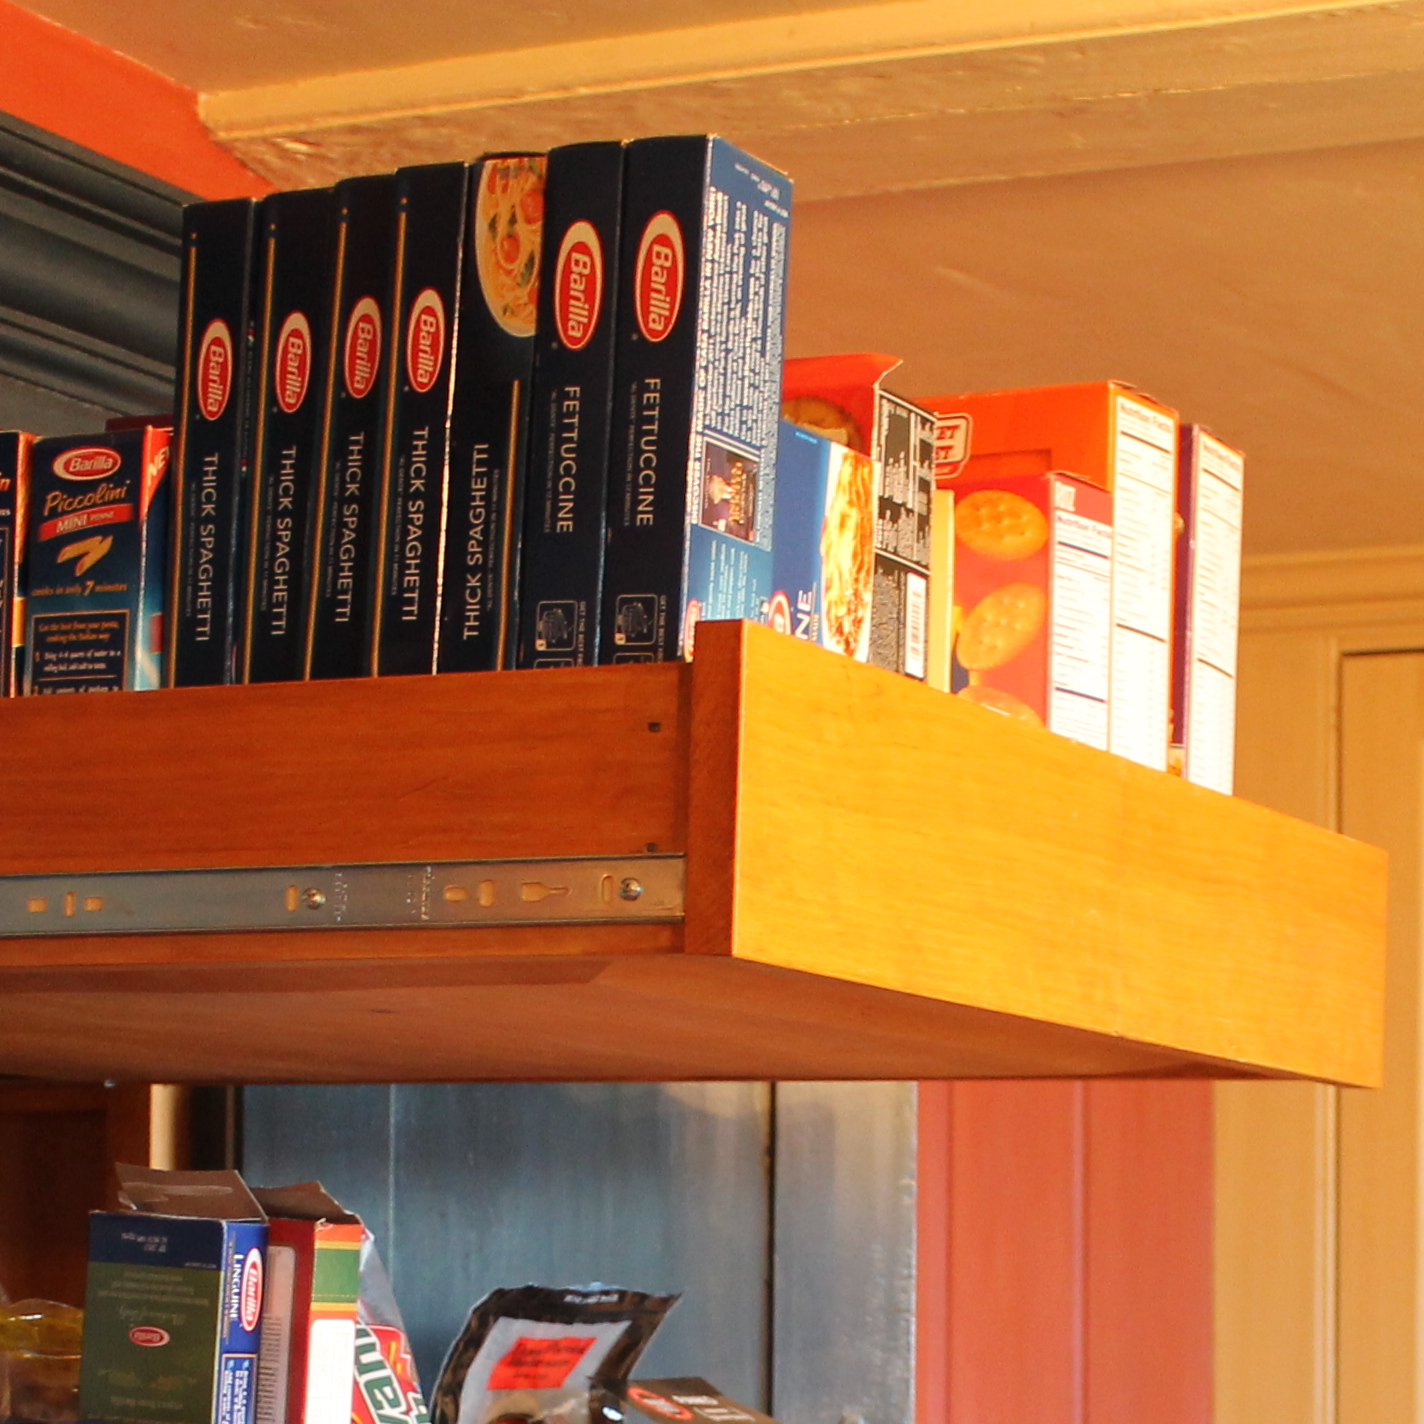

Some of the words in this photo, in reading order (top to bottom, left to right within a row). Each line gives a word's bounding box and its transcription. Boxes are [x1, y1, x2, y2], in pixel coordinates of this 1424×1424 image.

[566, 252, 591, 337] Barilla
[648, 244, 673, 330] Barilla
[205, 345, 225, 412] Barilla
[284, 337, 303, 403] Barilla
[354, 322, 374, 389] Barilla
[416, 314, 437, 382] Barilla
[68, 456, 113, 473] Barilla
[200, 453, 219, 517] THICK
[277, 445, 297, 510] THICK
[344, 432, 365, 496] THICK
[409, 426, 429, 493] THICK
[555, 386, 581, 533] FETTUCCINE
[635, 378, 662, 526] FETTUCCINE
[43, 479, 131, 517] Piccolini
[56, 517, 88, 534] MINI
[466, 443, 489, 565] SPAGHETTI
[84, 580, 94, 596] 7
[194, 525, 214, 641] SPAGHETTI
[270, 518, 291, 636] SPAGHETTI
[335, 504, 359, 623] SPAGHETTI
[401, 500, 425, 621] SPAGHETTI
[463, 573, 482, 640] THICK
[246, 1267, 258, 1321] Barilla
